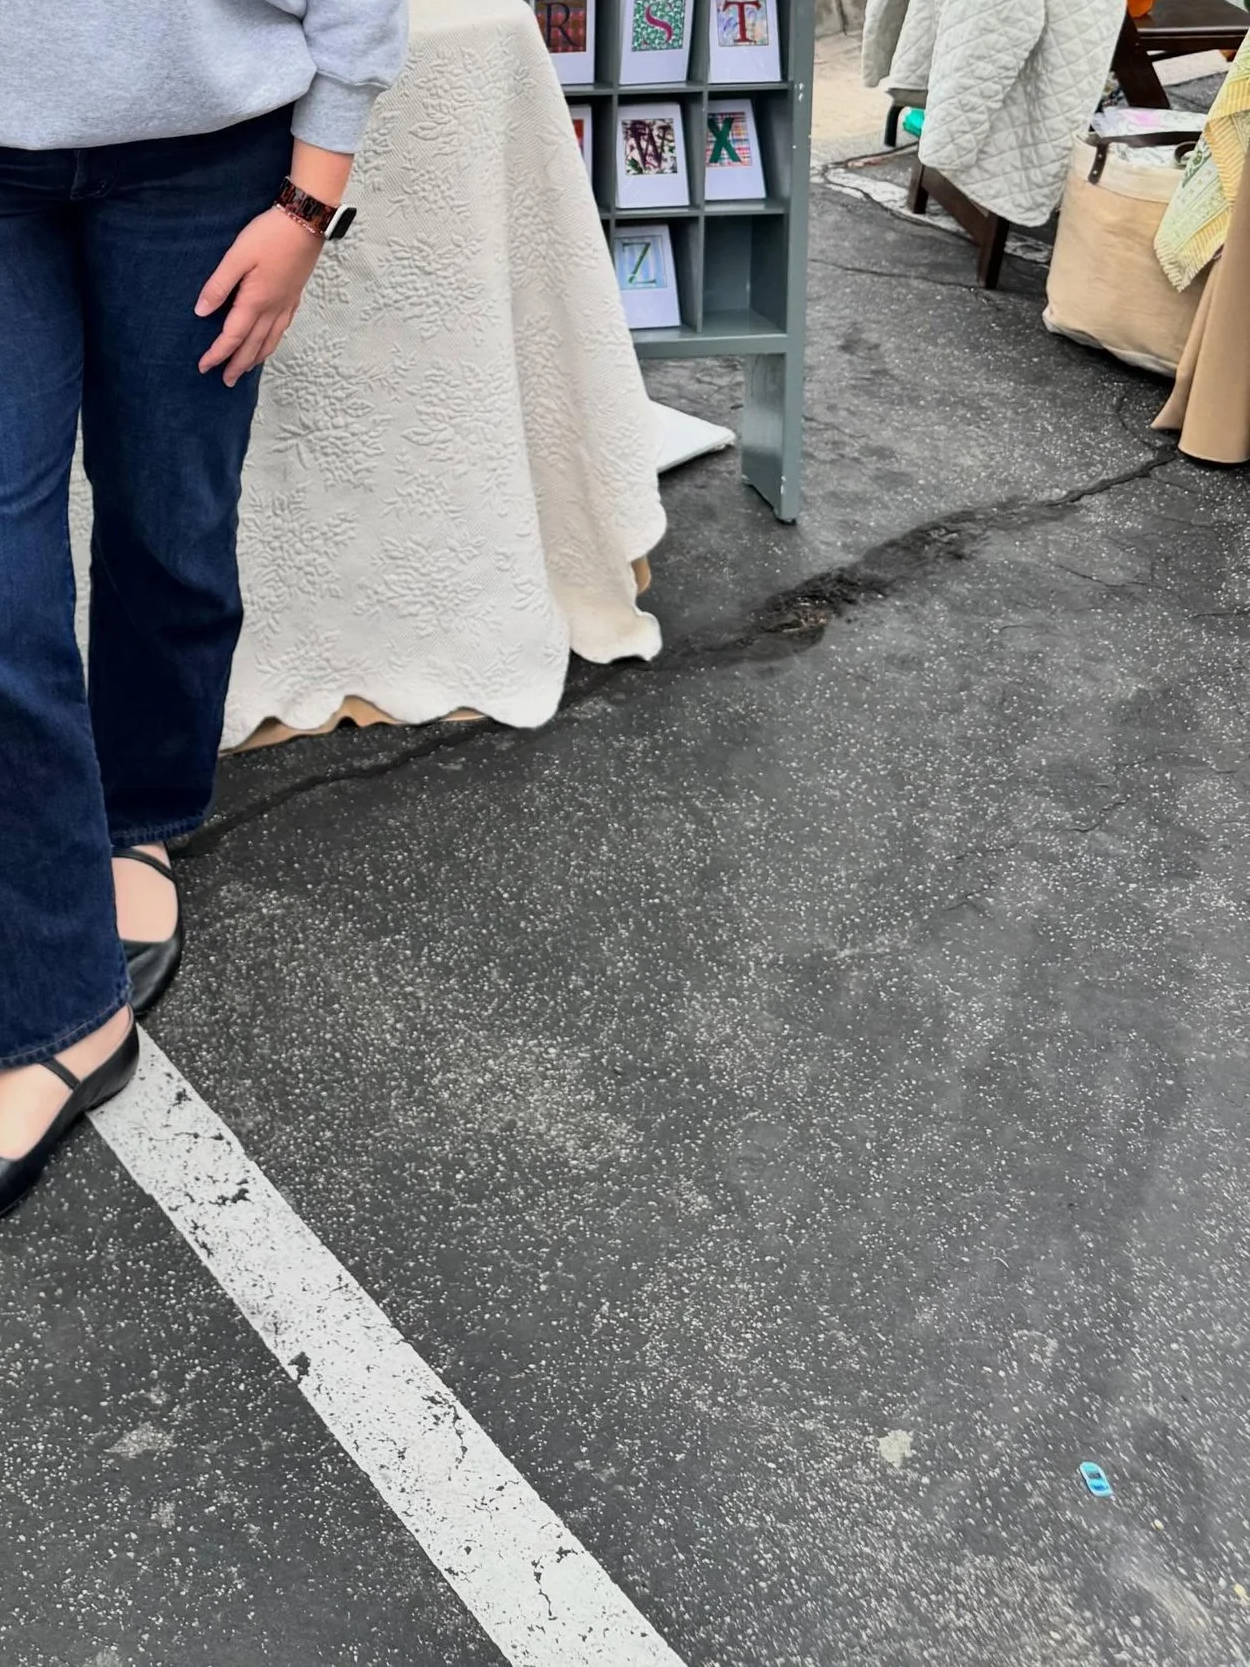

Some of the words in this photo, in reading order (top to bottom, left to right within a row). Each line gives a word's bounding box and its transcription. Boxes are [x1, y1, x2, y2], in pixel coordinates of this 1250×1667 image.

[543, 2, 581, 49] R
[642, 5, 673, 45] S
[723, 0, 762, 44] T
[629, 120, 673, 169] W
[708, 117, 741, 163] X
[622, 241, 656, 284] Z
